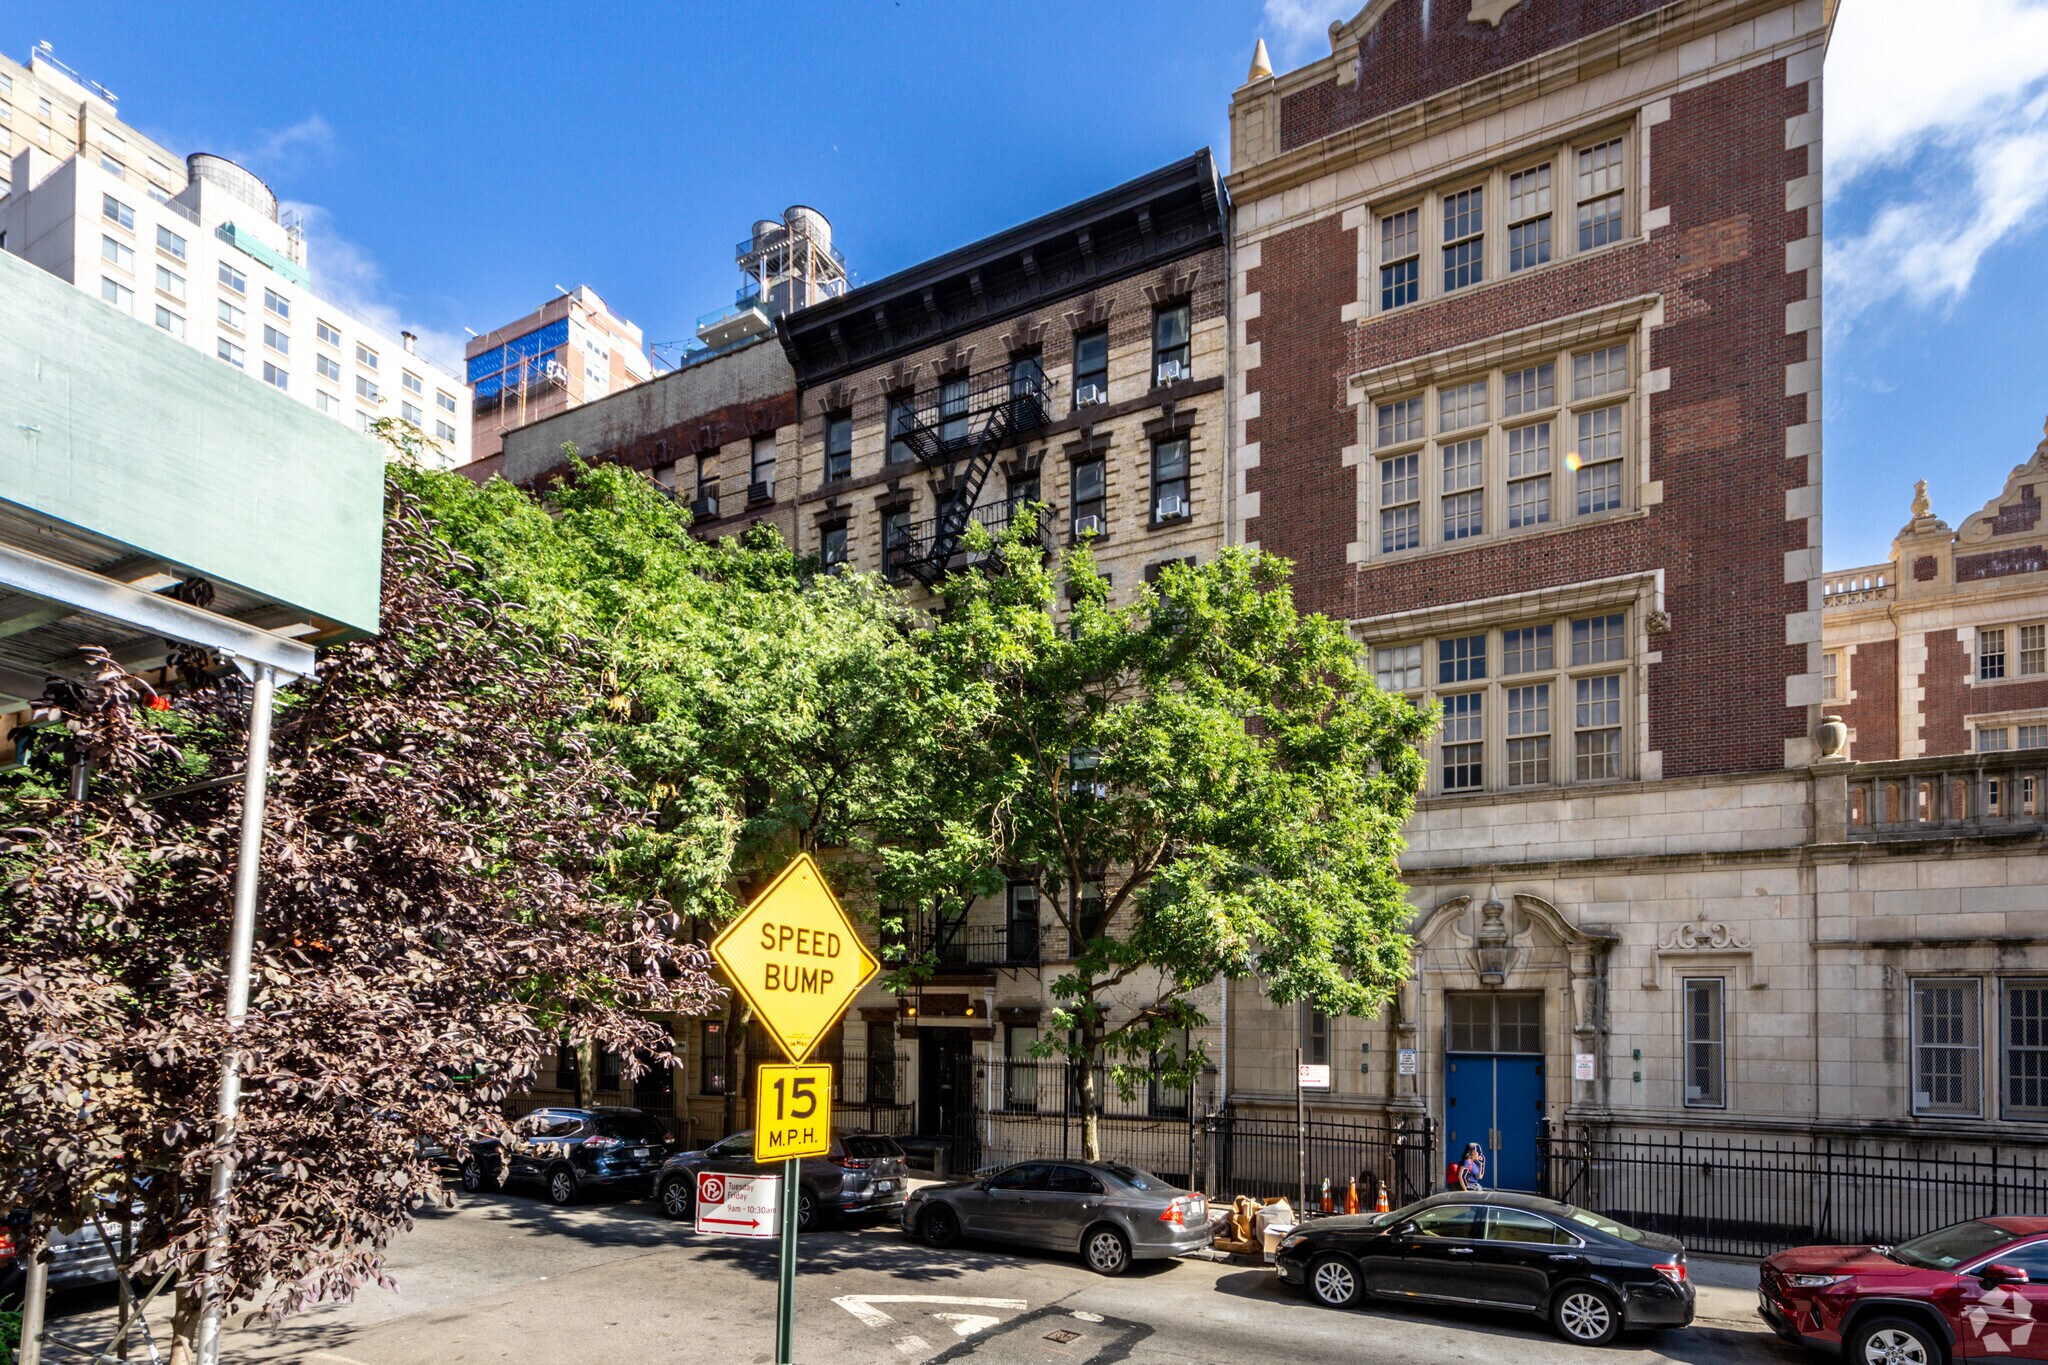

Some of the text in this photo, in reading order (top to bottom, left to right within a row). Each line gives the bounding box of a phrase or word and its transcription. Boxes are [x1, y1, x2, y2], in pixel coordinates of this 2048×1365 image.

[760, 922, 841, 958] SPEED
[764, 963, 834, 995] BUMP
[773, 1077, 817, 1121] 15
[769, 1127, 818, 1148] M.P.H.
[727, 1192, 747, 1202] Friday
[728, 1182, 754, 1193] Tuesday
[727, 1204, 742, 1213] 9am
[747, 1206, 777, 1215] 10:30am
